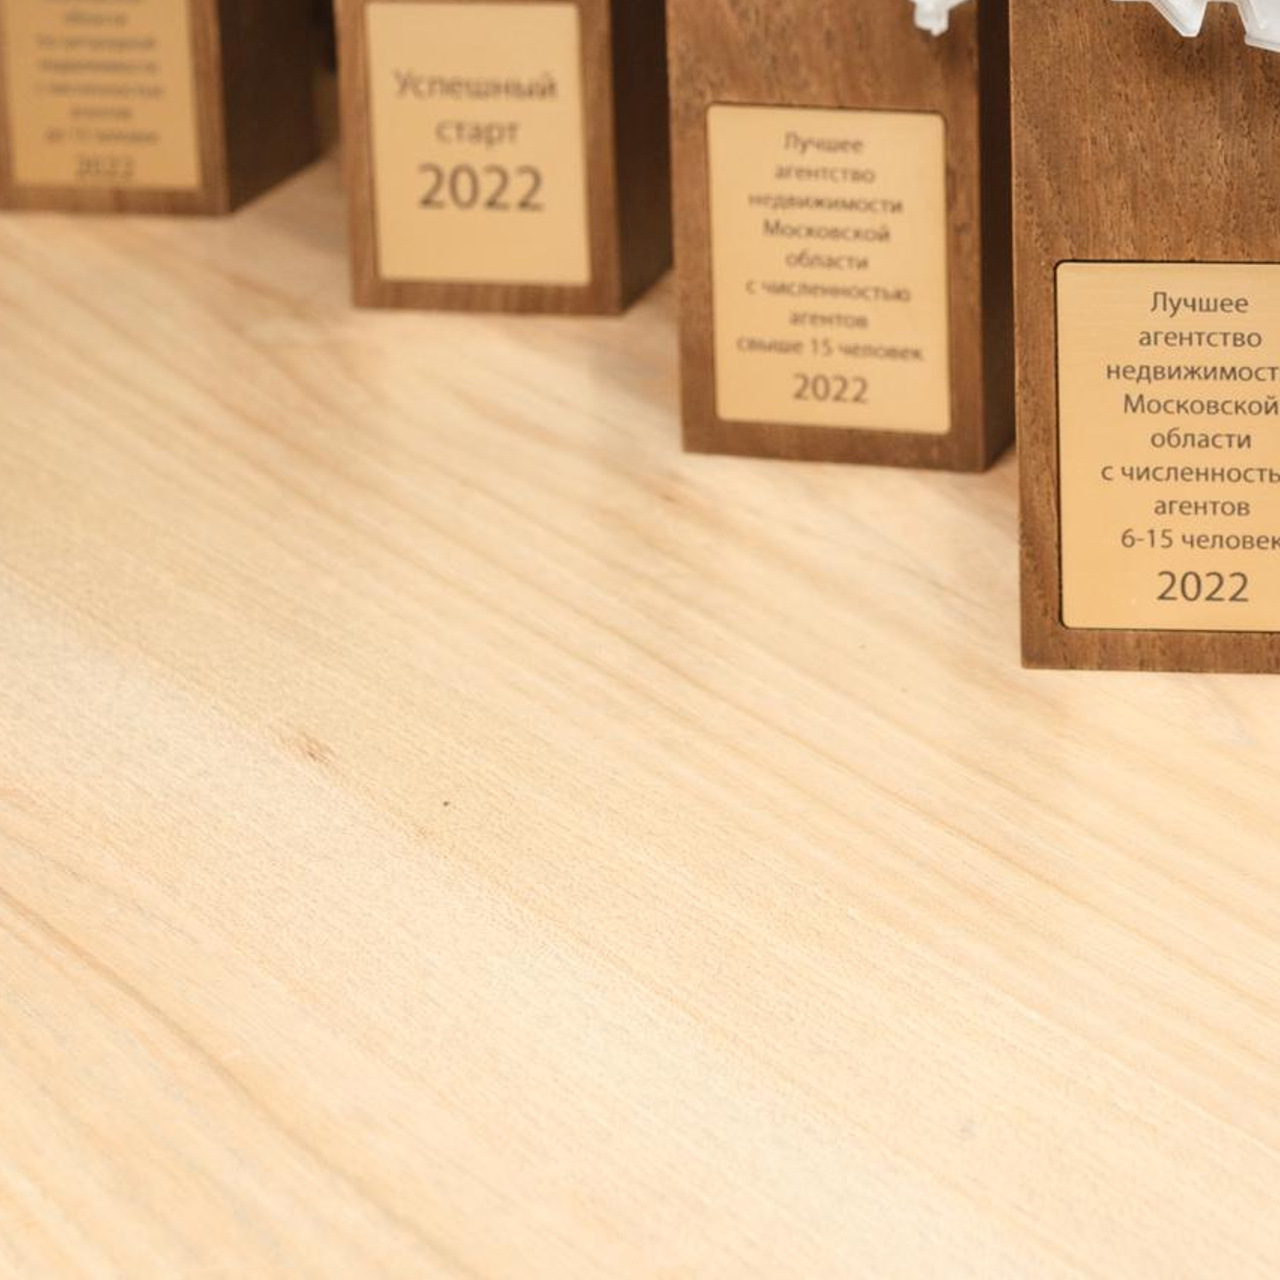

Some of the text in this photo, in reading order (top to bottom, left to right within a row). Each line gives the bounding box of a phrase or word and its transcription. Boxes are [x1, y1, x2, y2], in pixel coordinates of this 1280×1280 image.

[393, 68, 557, 99] Успешный
[435, 121, 519, 149] старт
[785, 131, 864, 155] Лучшее
[775, 164, 875, 184] агентство
[418, 163, 545, 210] 2022
[748, 193, 904, 214] недвижимости
[763, 219, 890, 243] Московской
[785, 250, 869, 270] области
[746, 279, 912, 303] с численностью
[1150, 291, 1249, 317] Лучшее
[789, 312, 869, 329] агентов
[737, 335, 923, 361] свыше 15 человек
[1138, 329, 1262, 348] агентство
[792, 373, 869, 404] 2022
[1123, 393, 1279, 416] Московской
[1150, 427, 1251, 450] области
[1101, 463, 1113, 481] с
[1154, 499, 1250, 517] агентов
[1121, 528, 1173, 549] 6-15
[1156, 570, 1249, 602] 2022
